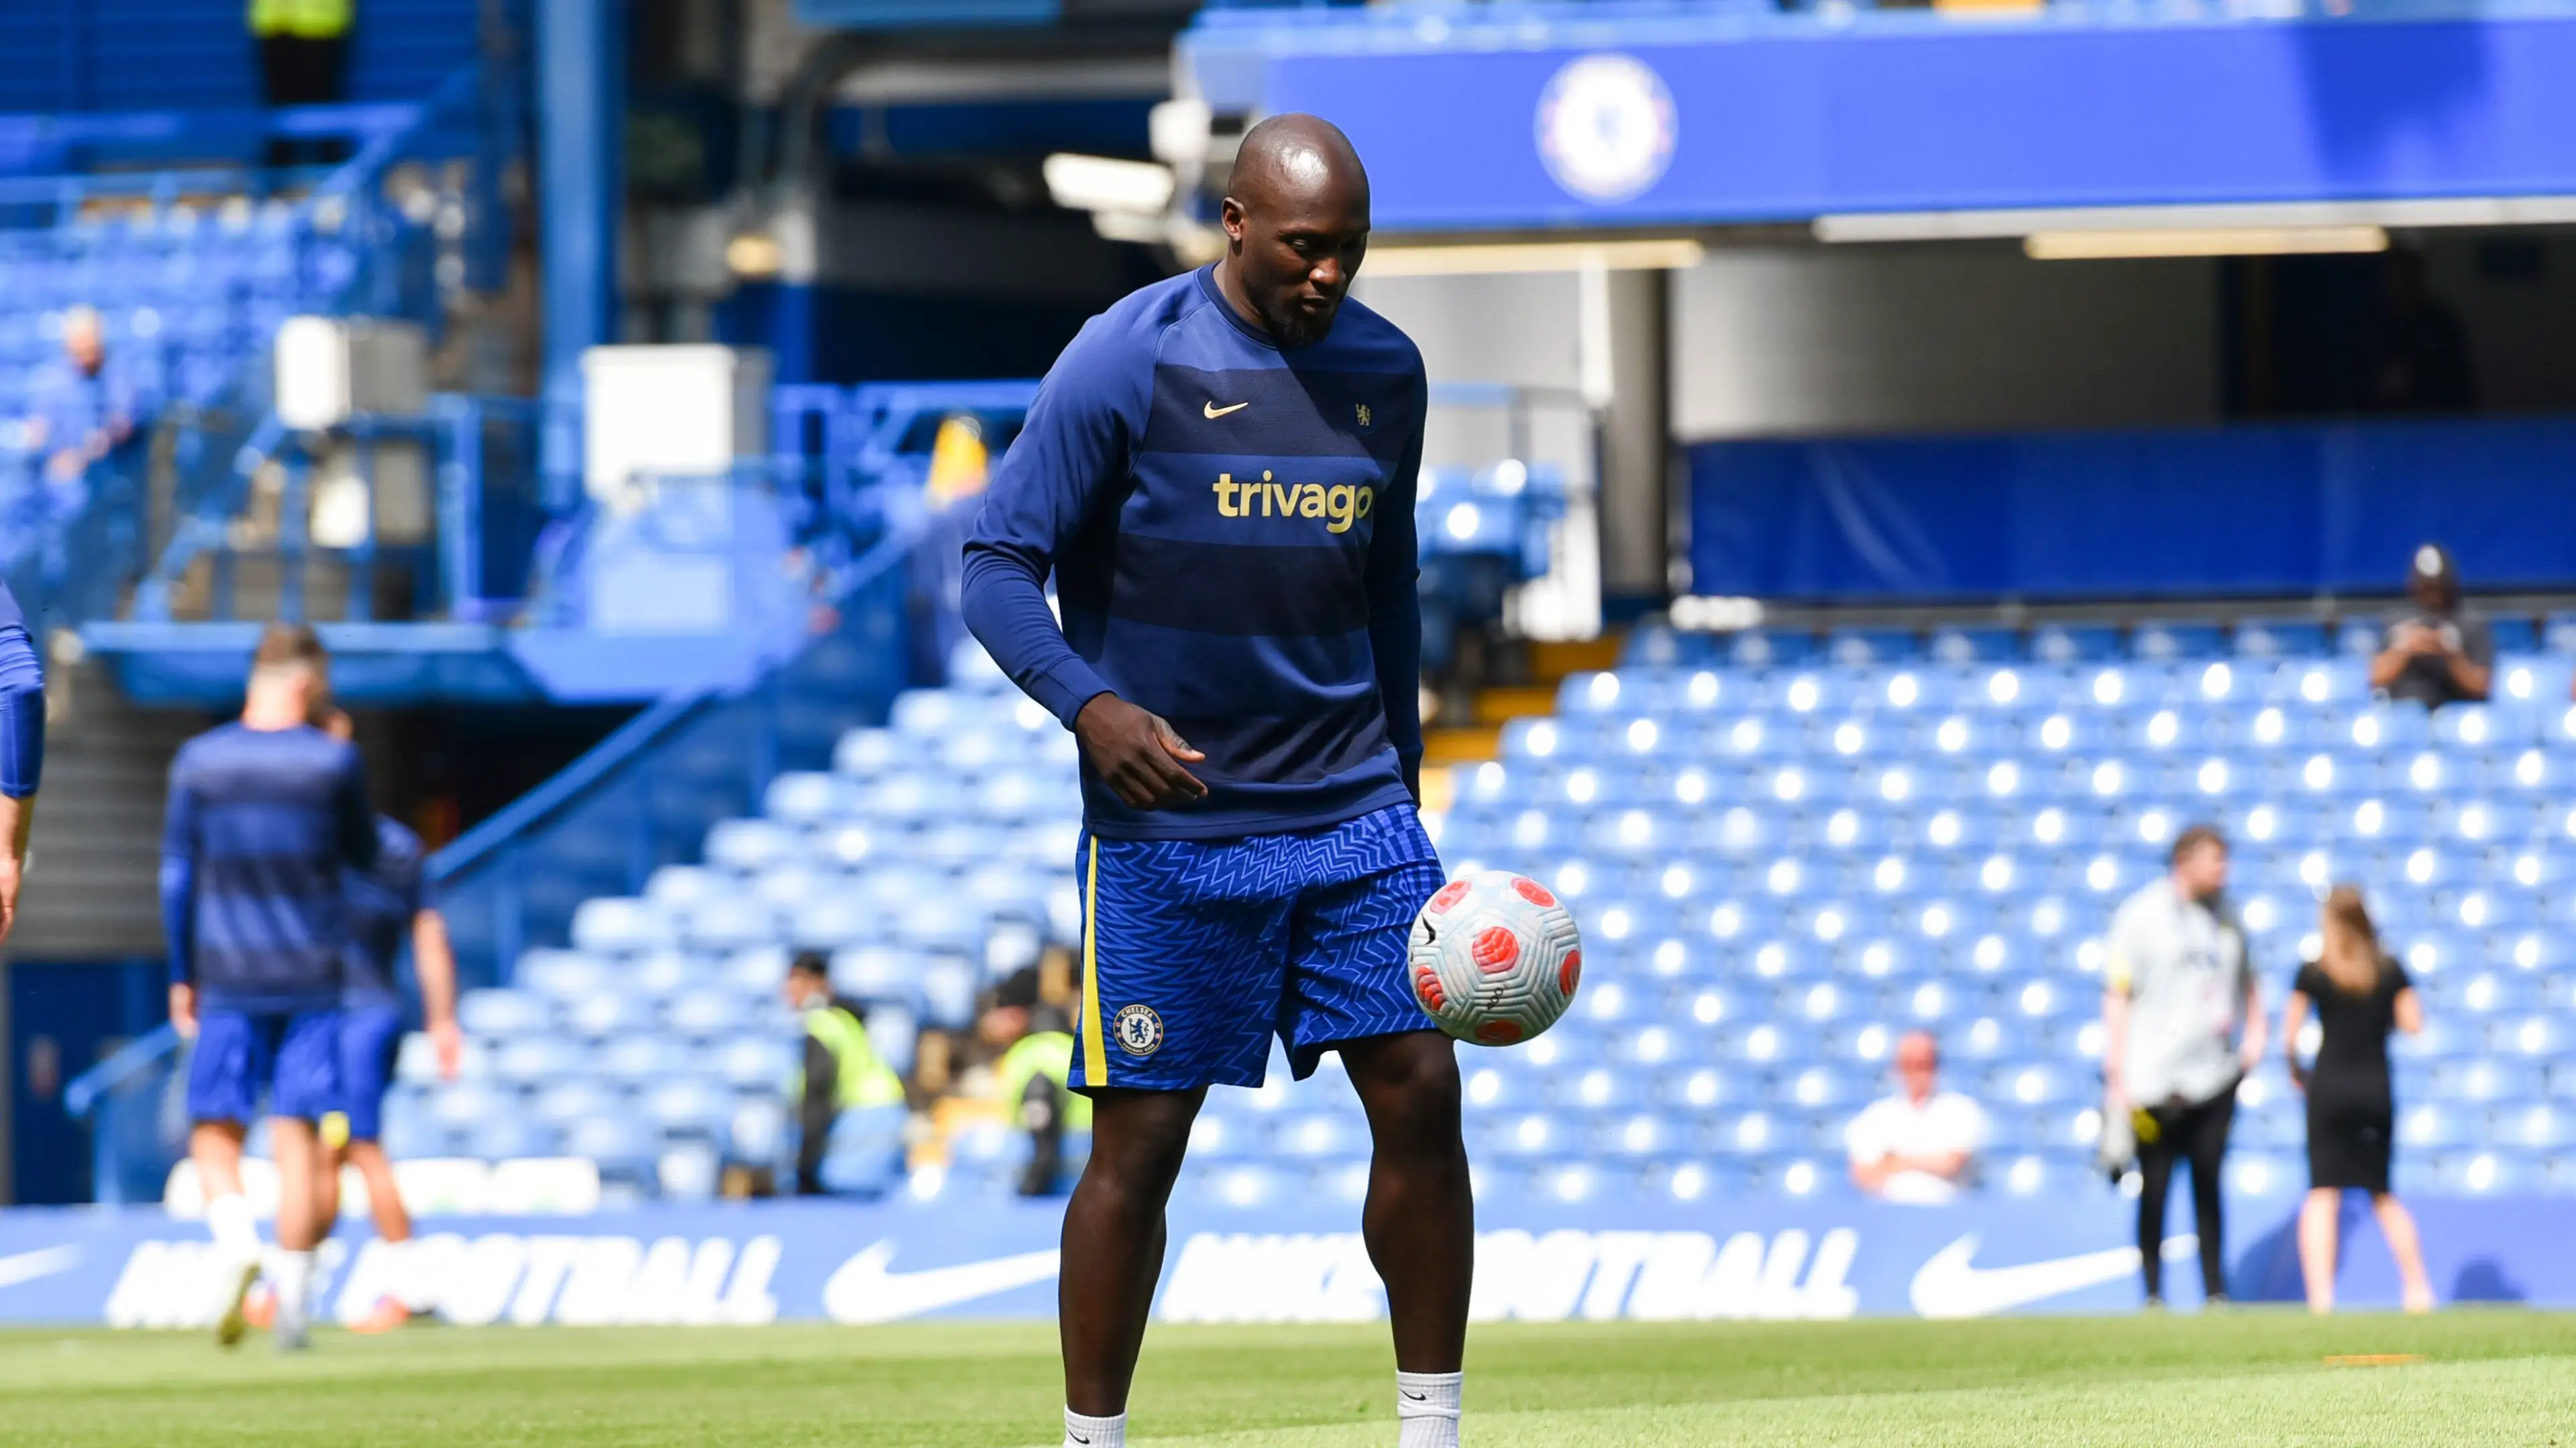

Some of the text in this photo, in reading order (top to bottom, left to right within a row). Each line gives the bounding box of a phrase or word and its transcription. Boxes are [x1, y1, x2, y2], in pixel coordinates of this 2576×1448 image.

[1212, 470, 1373, 533] trivago
[1122, 1007, 1152, 1017] CHELSEA
[1466, 1229, 1860, 1321] OOTBALL
